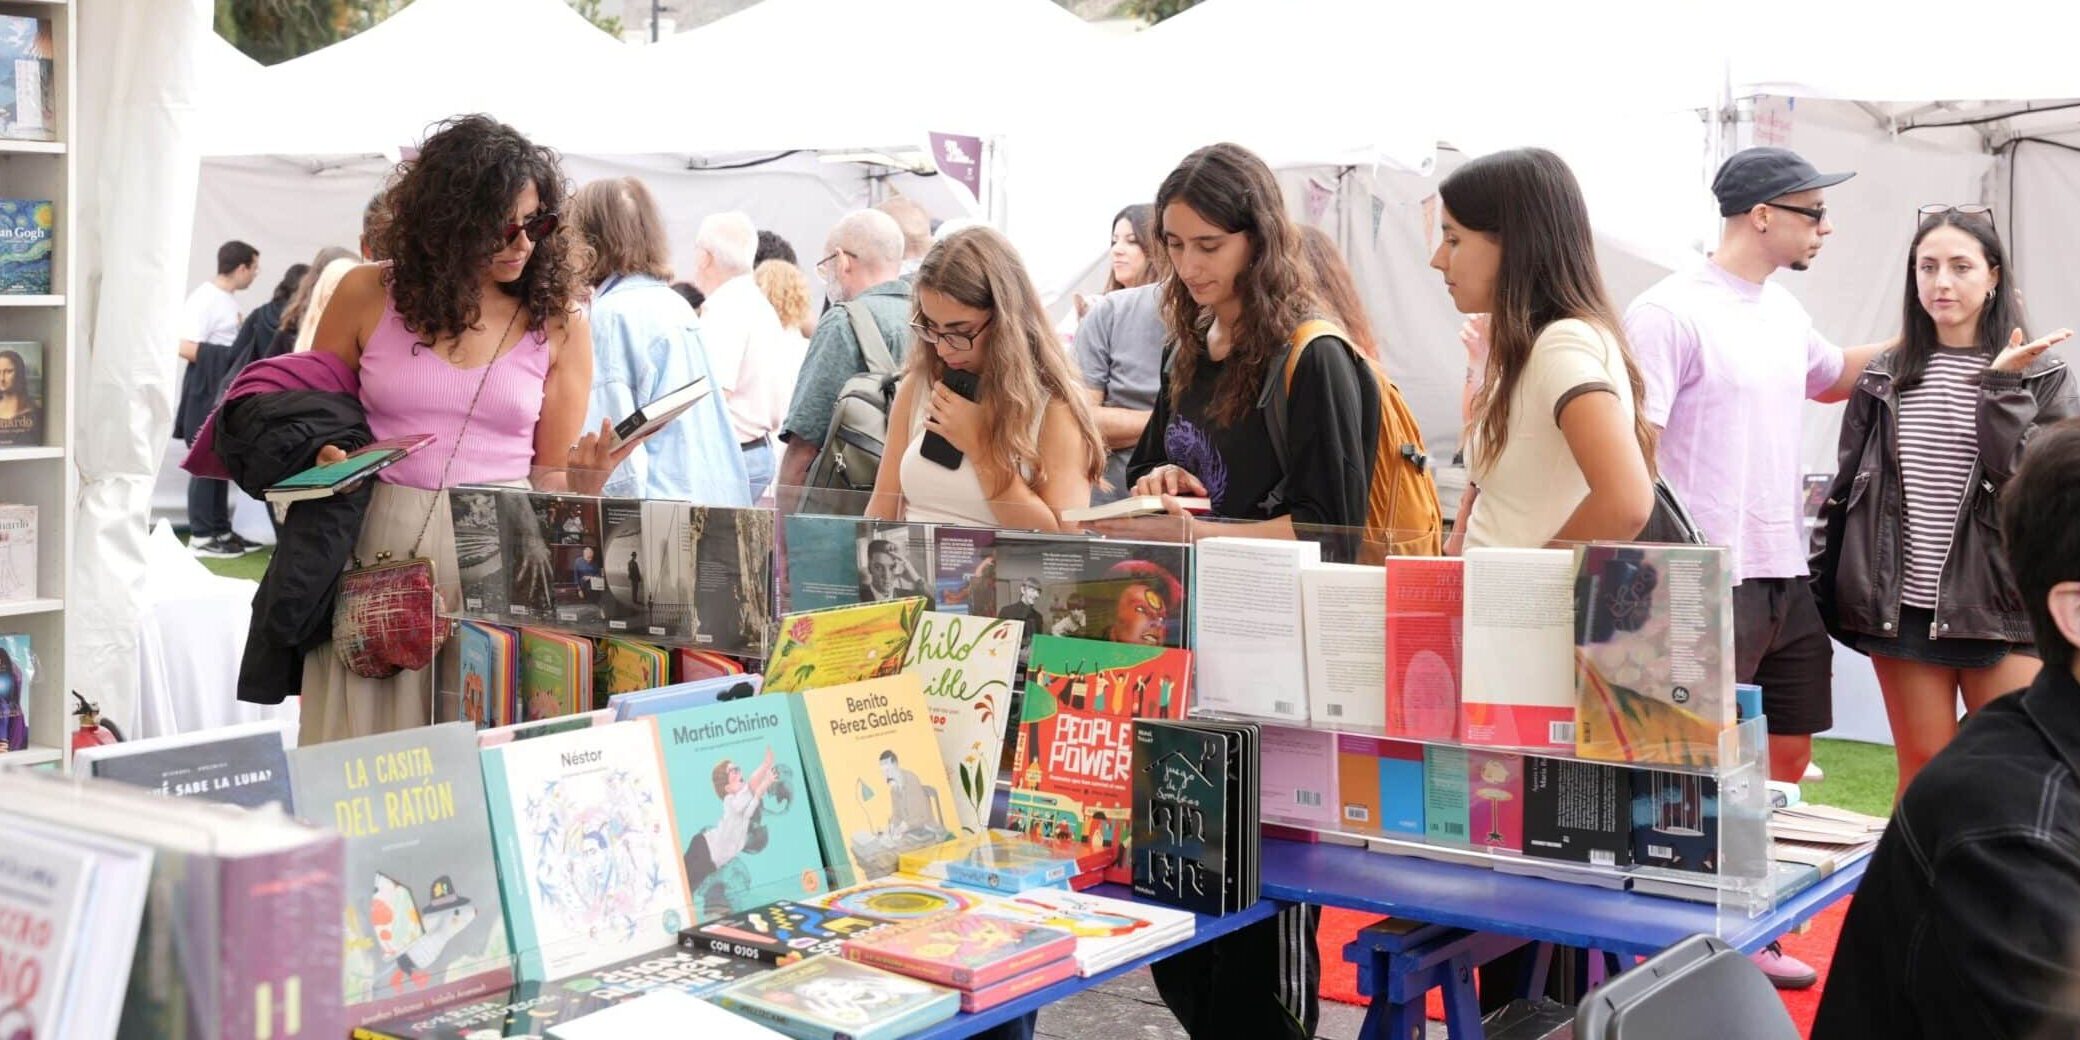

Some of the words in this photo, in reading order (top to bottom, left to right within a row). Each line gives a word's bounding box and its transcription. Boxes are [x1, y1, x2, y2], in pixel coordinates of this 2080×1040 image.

[0, 229, 12, 238] an
[14, 227, 45, 241] Gogh
[923, 668, 988, 700] ible
[846, 693, 888, 713] Benito
[726, 712, 779, 735] Chirino
[830, 715, 867, 736] Pérez
[868, 708, 914, 728] Galdós
[1054, 713, 1131, 751] PEOPLE
[344, 759, 369, 790] LA
[375, 747, 434, 783] CASITA
[561, 749, 603, 768] Néstor
[1049, 741, 1132, 781] POWER
[175, 780, 209, 798] SABE
[213, 777, 230, 790] LA
[234, 769, 272, 786] LUNA?
[335, 797, 380, 838] DEL
[385, 777, 455, 829] RATÓN
[710, 939, 731, 954] CON
[734, 944, 759, 960] OJOS
